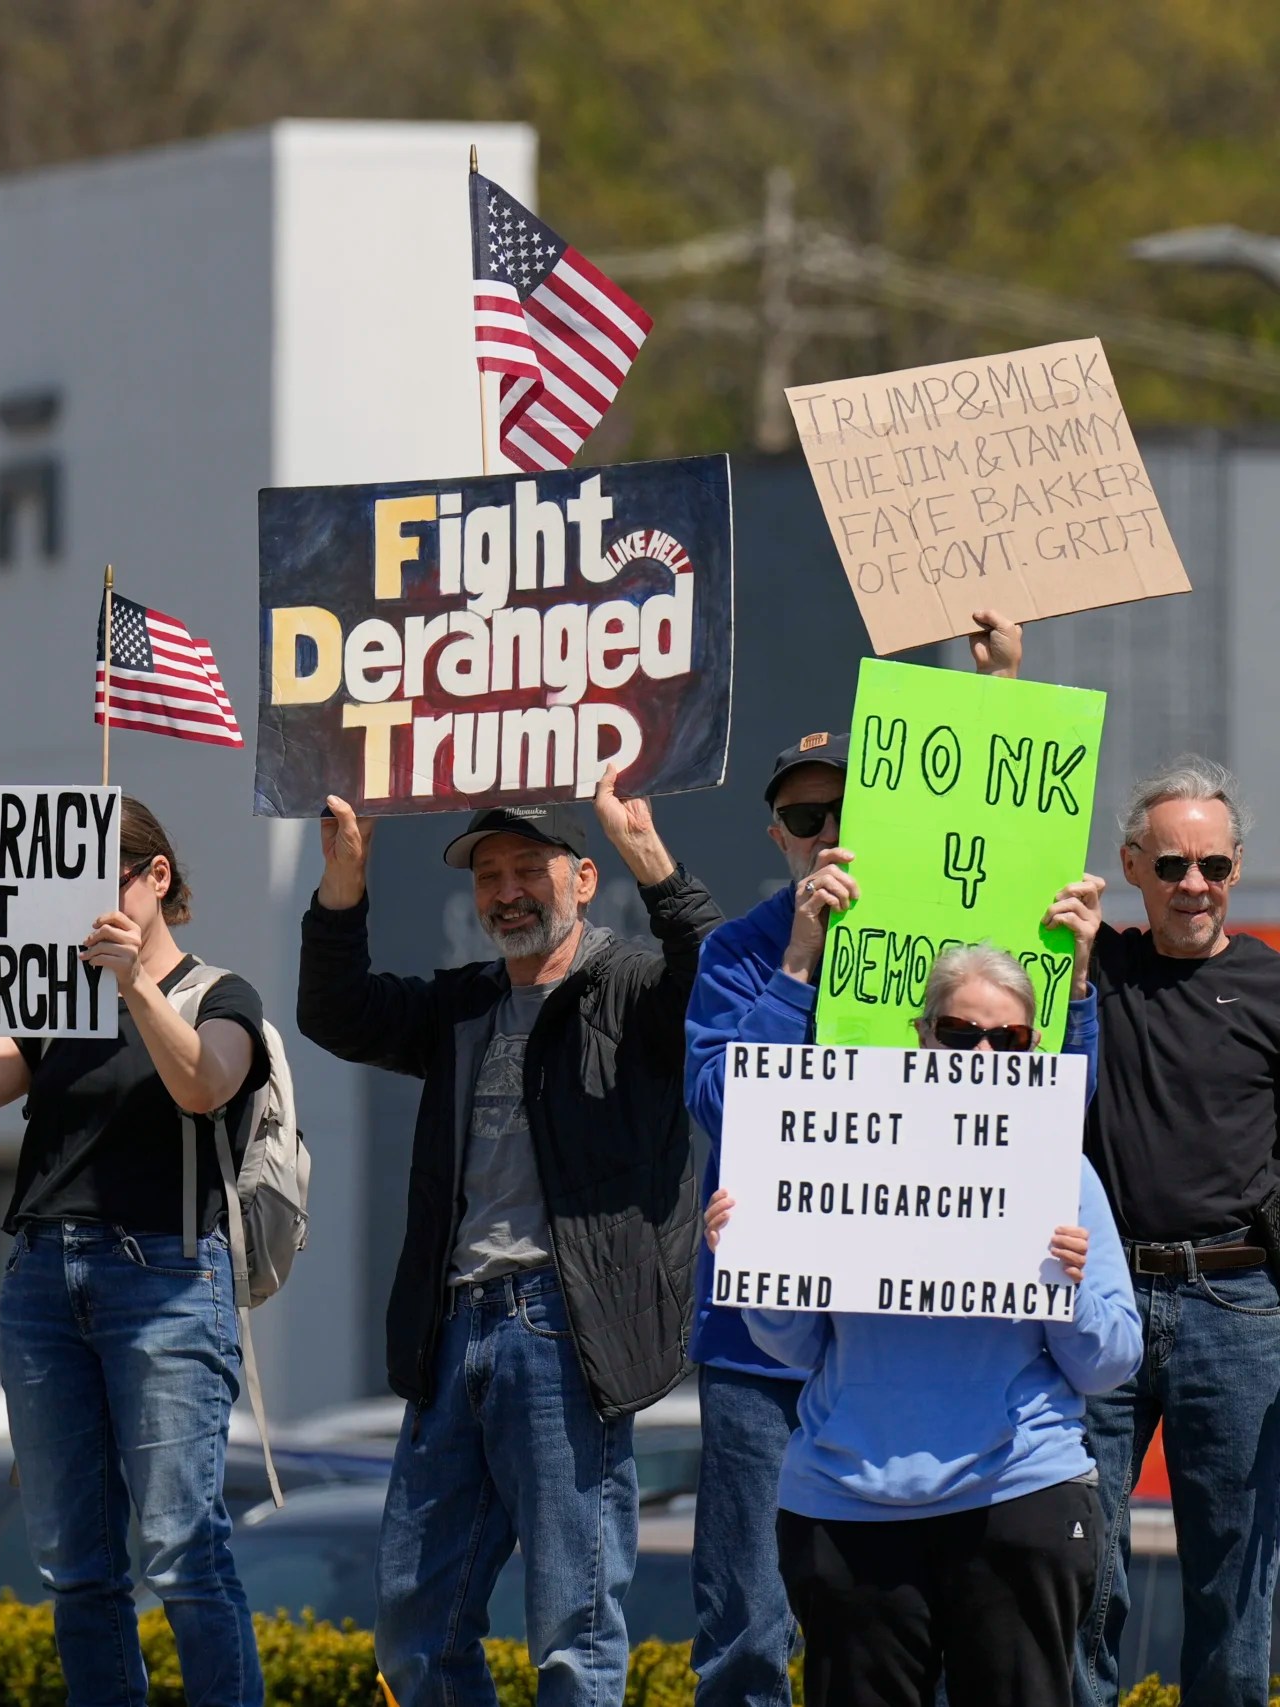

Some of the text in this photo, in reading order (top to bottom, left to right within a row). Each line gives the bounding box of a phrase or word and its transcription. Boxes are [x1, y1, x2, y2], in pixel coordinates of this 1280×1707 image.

[815, 453, 894, 503] THE
[838, 462, 1152, 556] FAYE BAKKER
[375, 474, 617, 617] Fight
[605, 529, 690, 574] LIKE HELL
[857, 551, 908, 595] OF
[1035, 506, 1158, 560] GRIFT
[271, 572, 695, 707] Deranged
[342, 701, 642, 800] Trump
[860, 715, 1086, 816] HONK
[944, 832, 986, 909] 4
[829, 925, 1072, 1028] DEMOY
[734, 1046, 1058, 1087] REJECT FASCISM!
[781, 1110, 1009, 1146] REJECT THE
[777, 1180, 1006, 1218] BROLIGARCHY!
[716, 1269, 1072, 1316] DEFEND DEMOCRACY!
